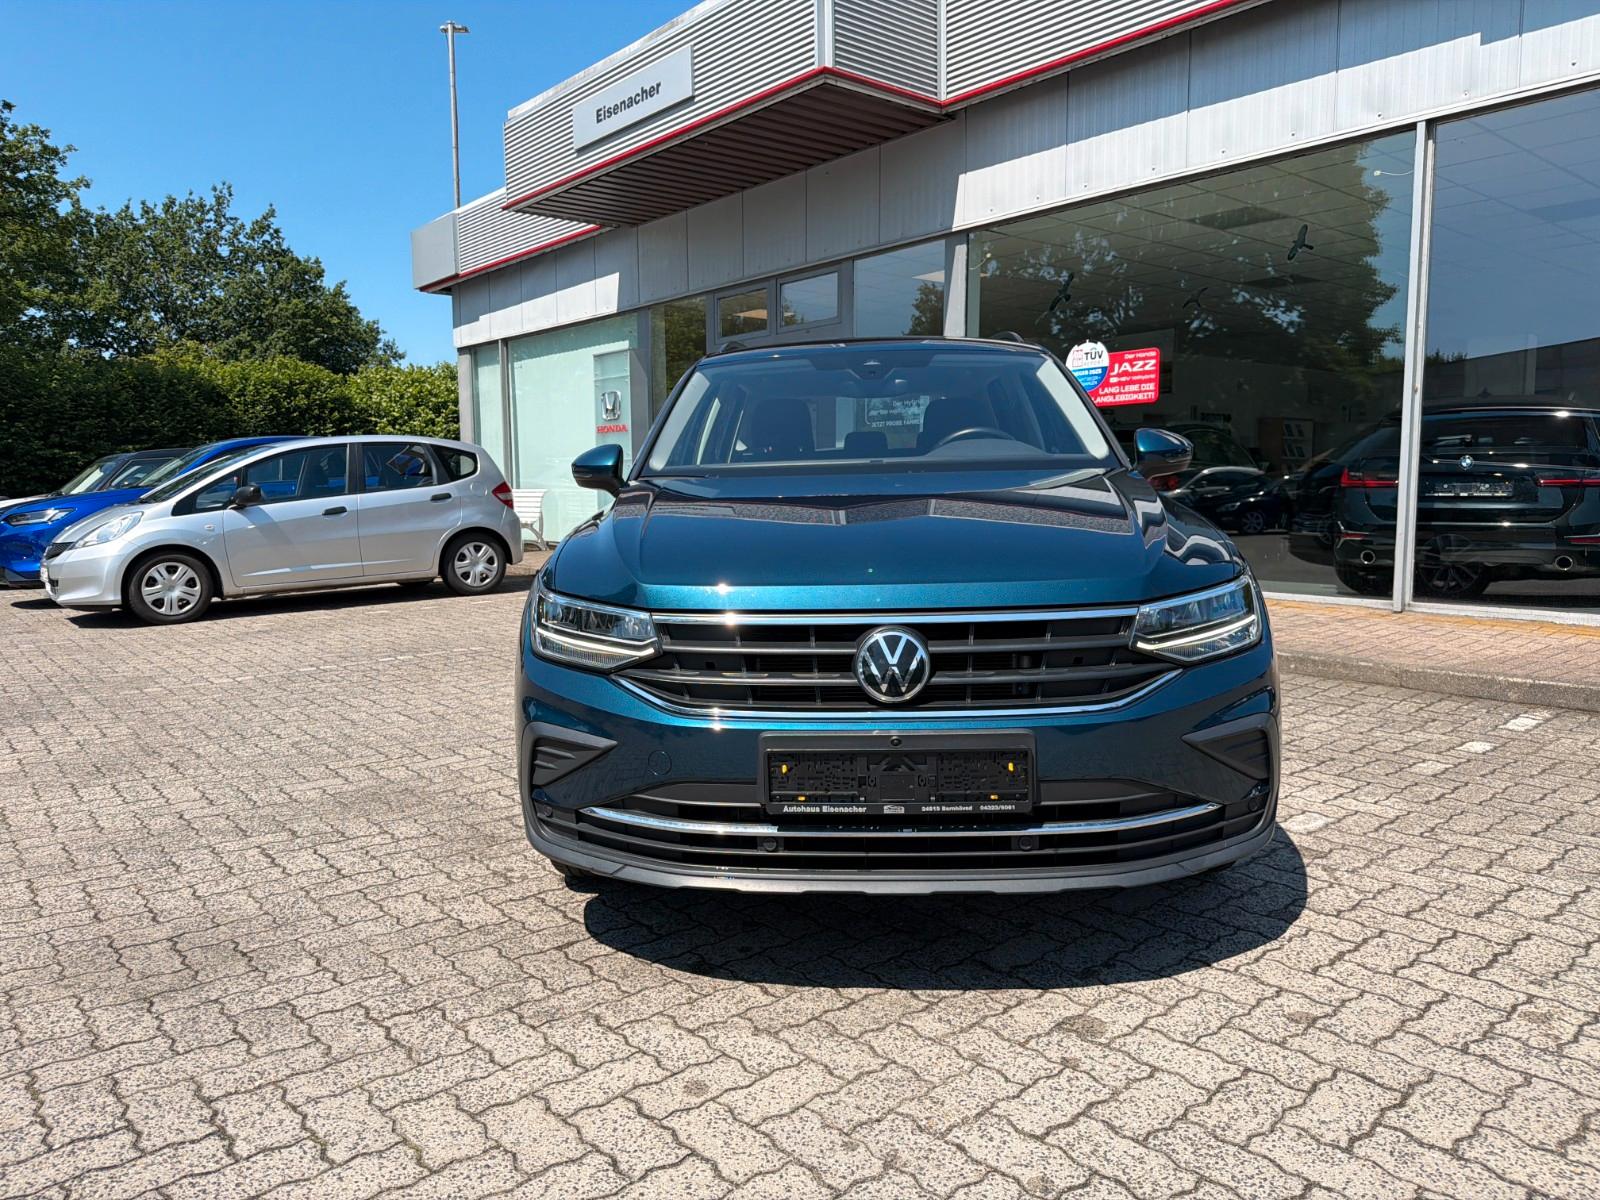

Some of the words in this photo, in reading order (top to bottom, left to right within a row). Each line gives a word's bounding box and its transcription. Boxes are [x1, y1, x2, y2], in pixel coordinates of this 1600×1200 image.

[595, 82, 662, 124] Eisenacher
[1084, 349, 1104, 361] TÜV
[1110, 360, 1157, 376] JAZZ
[1099, 386, 1119, 394] LANG
[1120, 384, 1140, 392] LEBE
[596, 424, 628, 433] HONDA
[783, 804, 820, 813] Autohaus
[822, 805, 867, 813] Eisenacher
